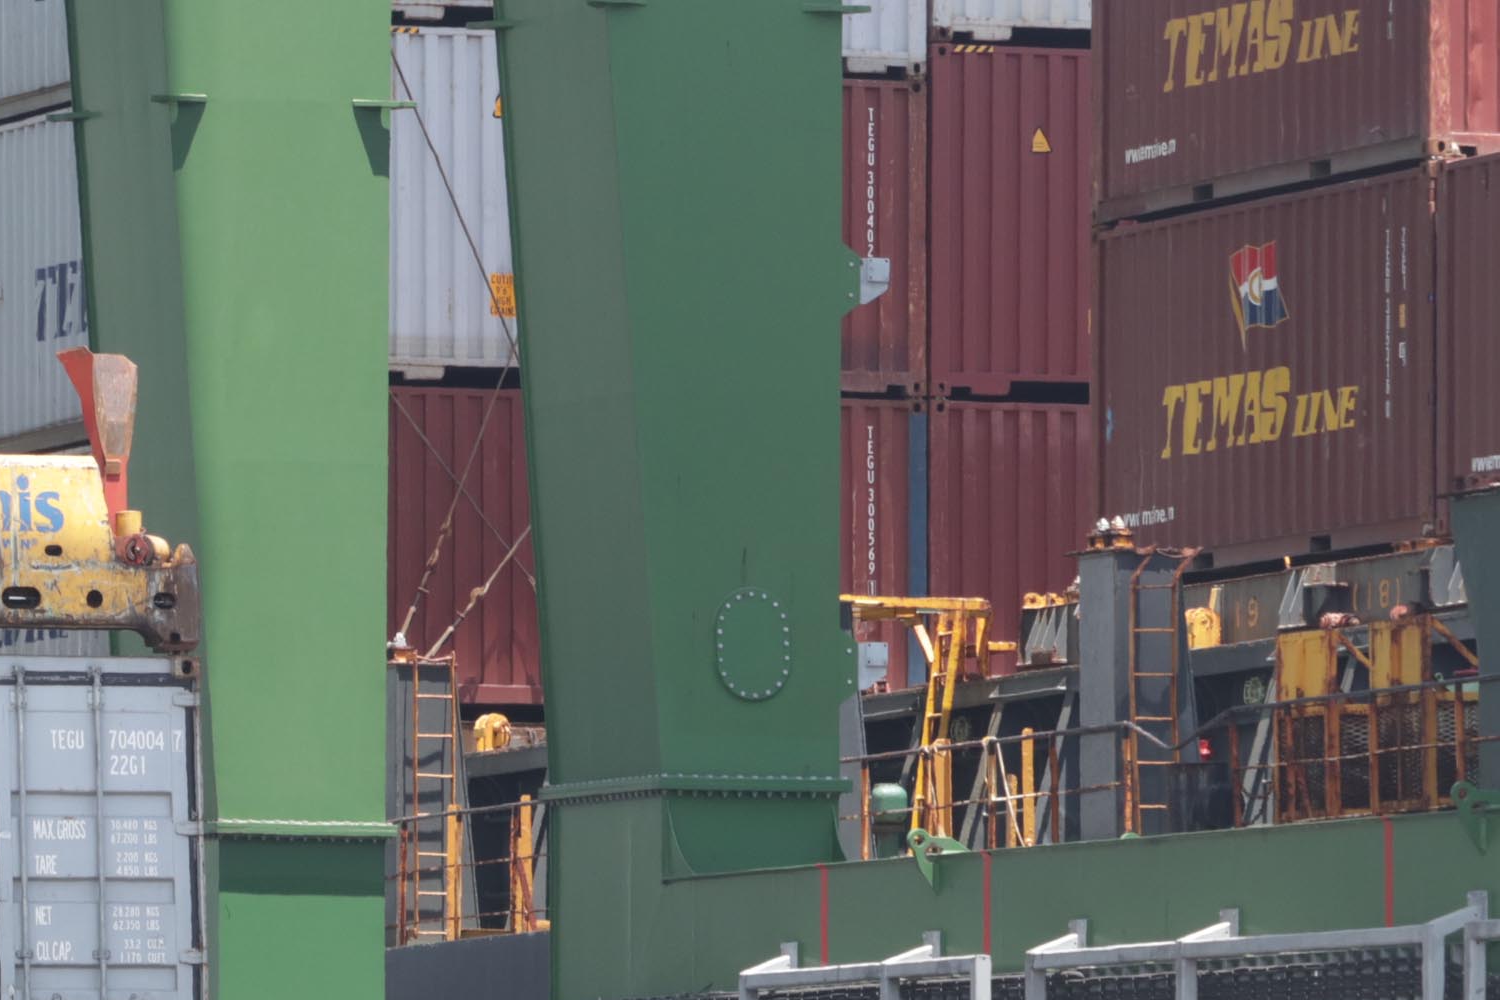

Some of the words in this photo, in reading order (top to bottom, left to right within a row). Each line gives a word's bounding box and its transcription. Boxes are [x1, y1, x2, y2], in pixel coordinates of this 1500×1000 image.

[1163, 0, 1294, 93] TEMAS
[867, 107, 875, 166] TEGU
[867, 170, 875, 258] 300402
[1161, 365, 1291, 459] TEMAS
[867, 425, 875, 484] TEGU
[867, 487, 876, 576] 300569
[50, 729, 85, 750] TEGU
[109, 729, 165, 751] 704004
[110, 754, 146, 776] 22G1
[35, 854, 58, 875] TARE
[35, 905, 52, 926] NET
